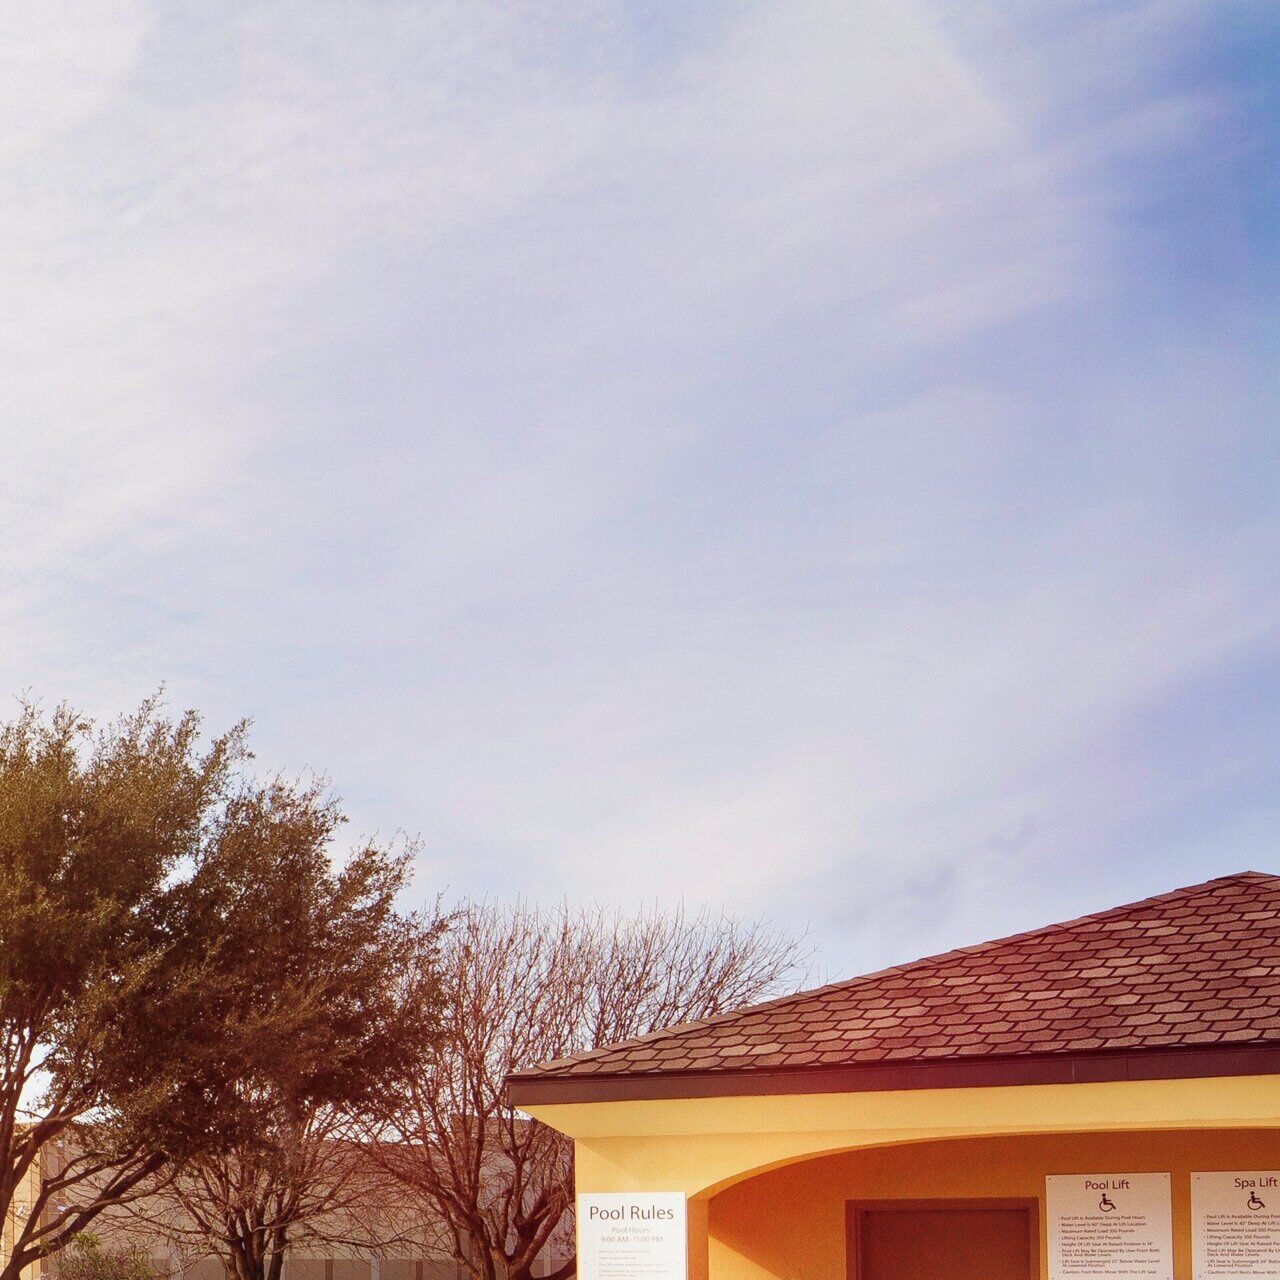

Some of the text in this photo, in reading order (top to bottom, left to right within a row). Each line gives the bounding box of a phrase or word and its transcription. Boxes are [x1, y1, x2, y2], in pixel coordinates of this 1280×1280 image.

[1085, 1180, 1130, 1190] Pool Lift
[1234, 1177, 1278, 1189] Spa Lift
[590, 1205, 674, 1220] Pool Rules
